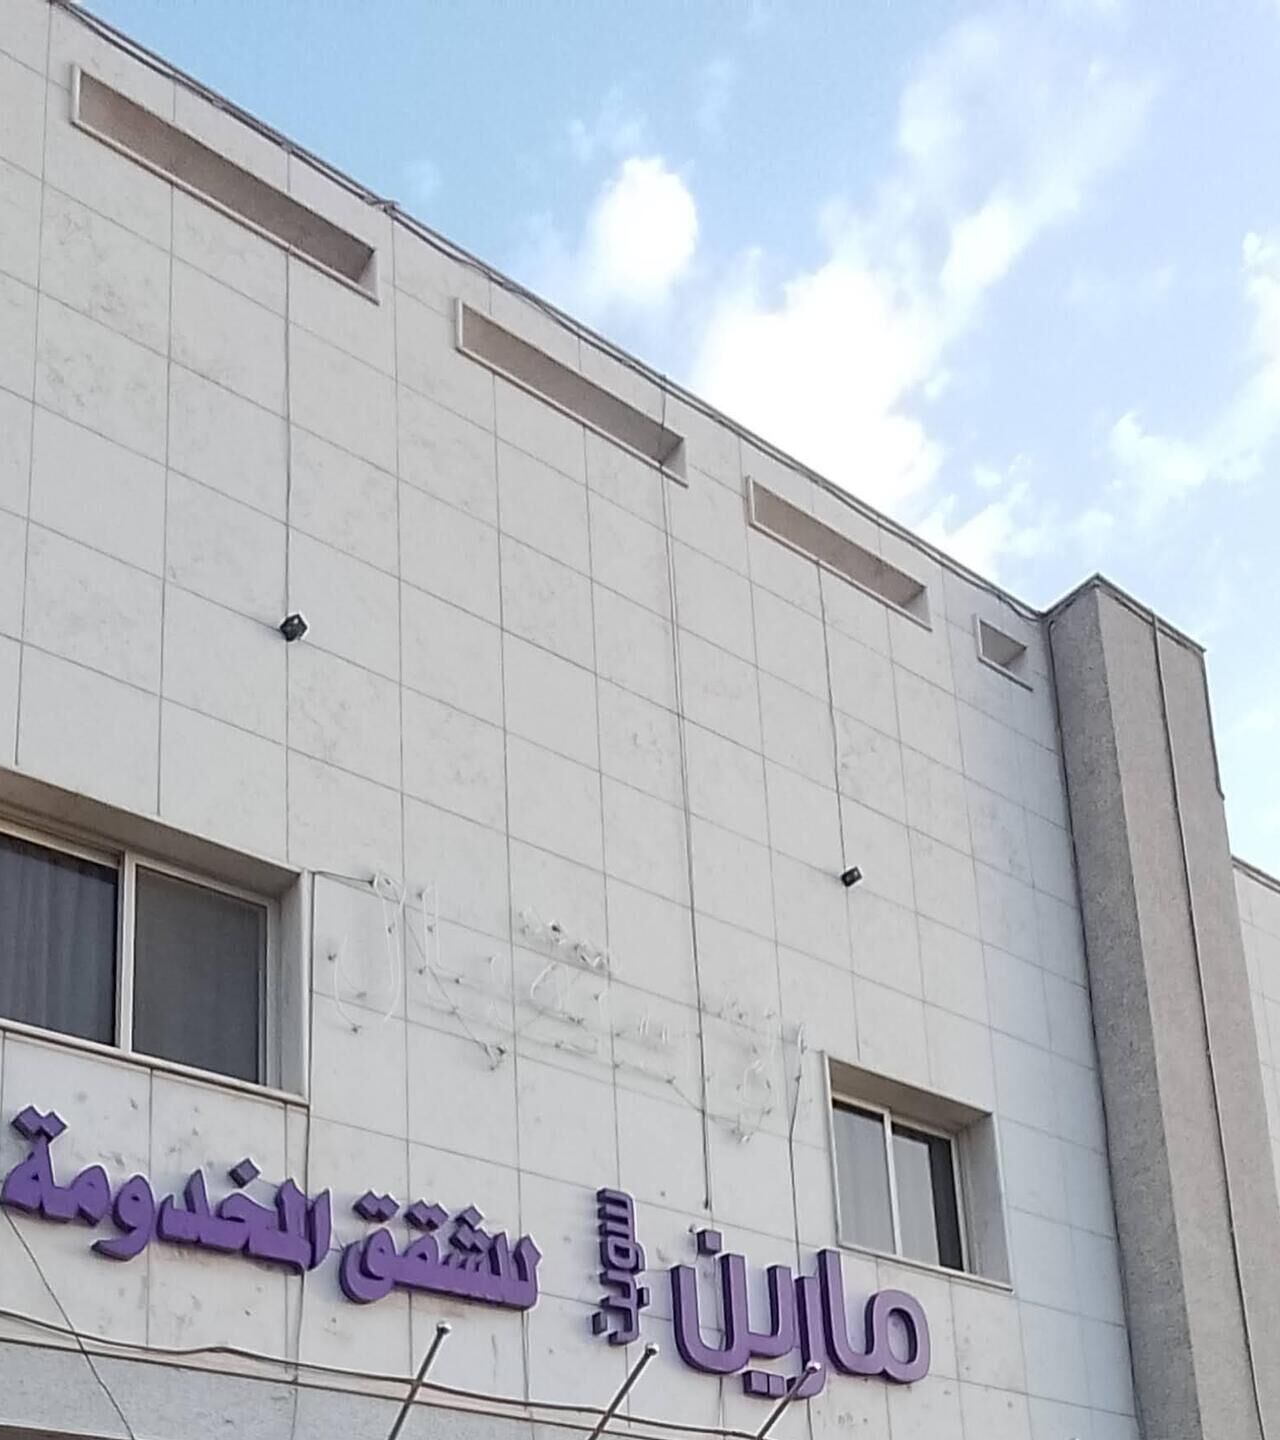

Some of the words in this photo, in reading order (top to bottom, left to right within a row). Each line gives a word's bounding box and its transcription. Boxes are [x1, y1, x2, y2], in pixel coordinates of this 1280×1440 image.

[1, 1104, 333, 1275] المخدومة
[338, 1189, 543, 1312] للشقق
[592, 1187, 650, 1346] سويت
[670, 1229, 931, 1401] مارين
